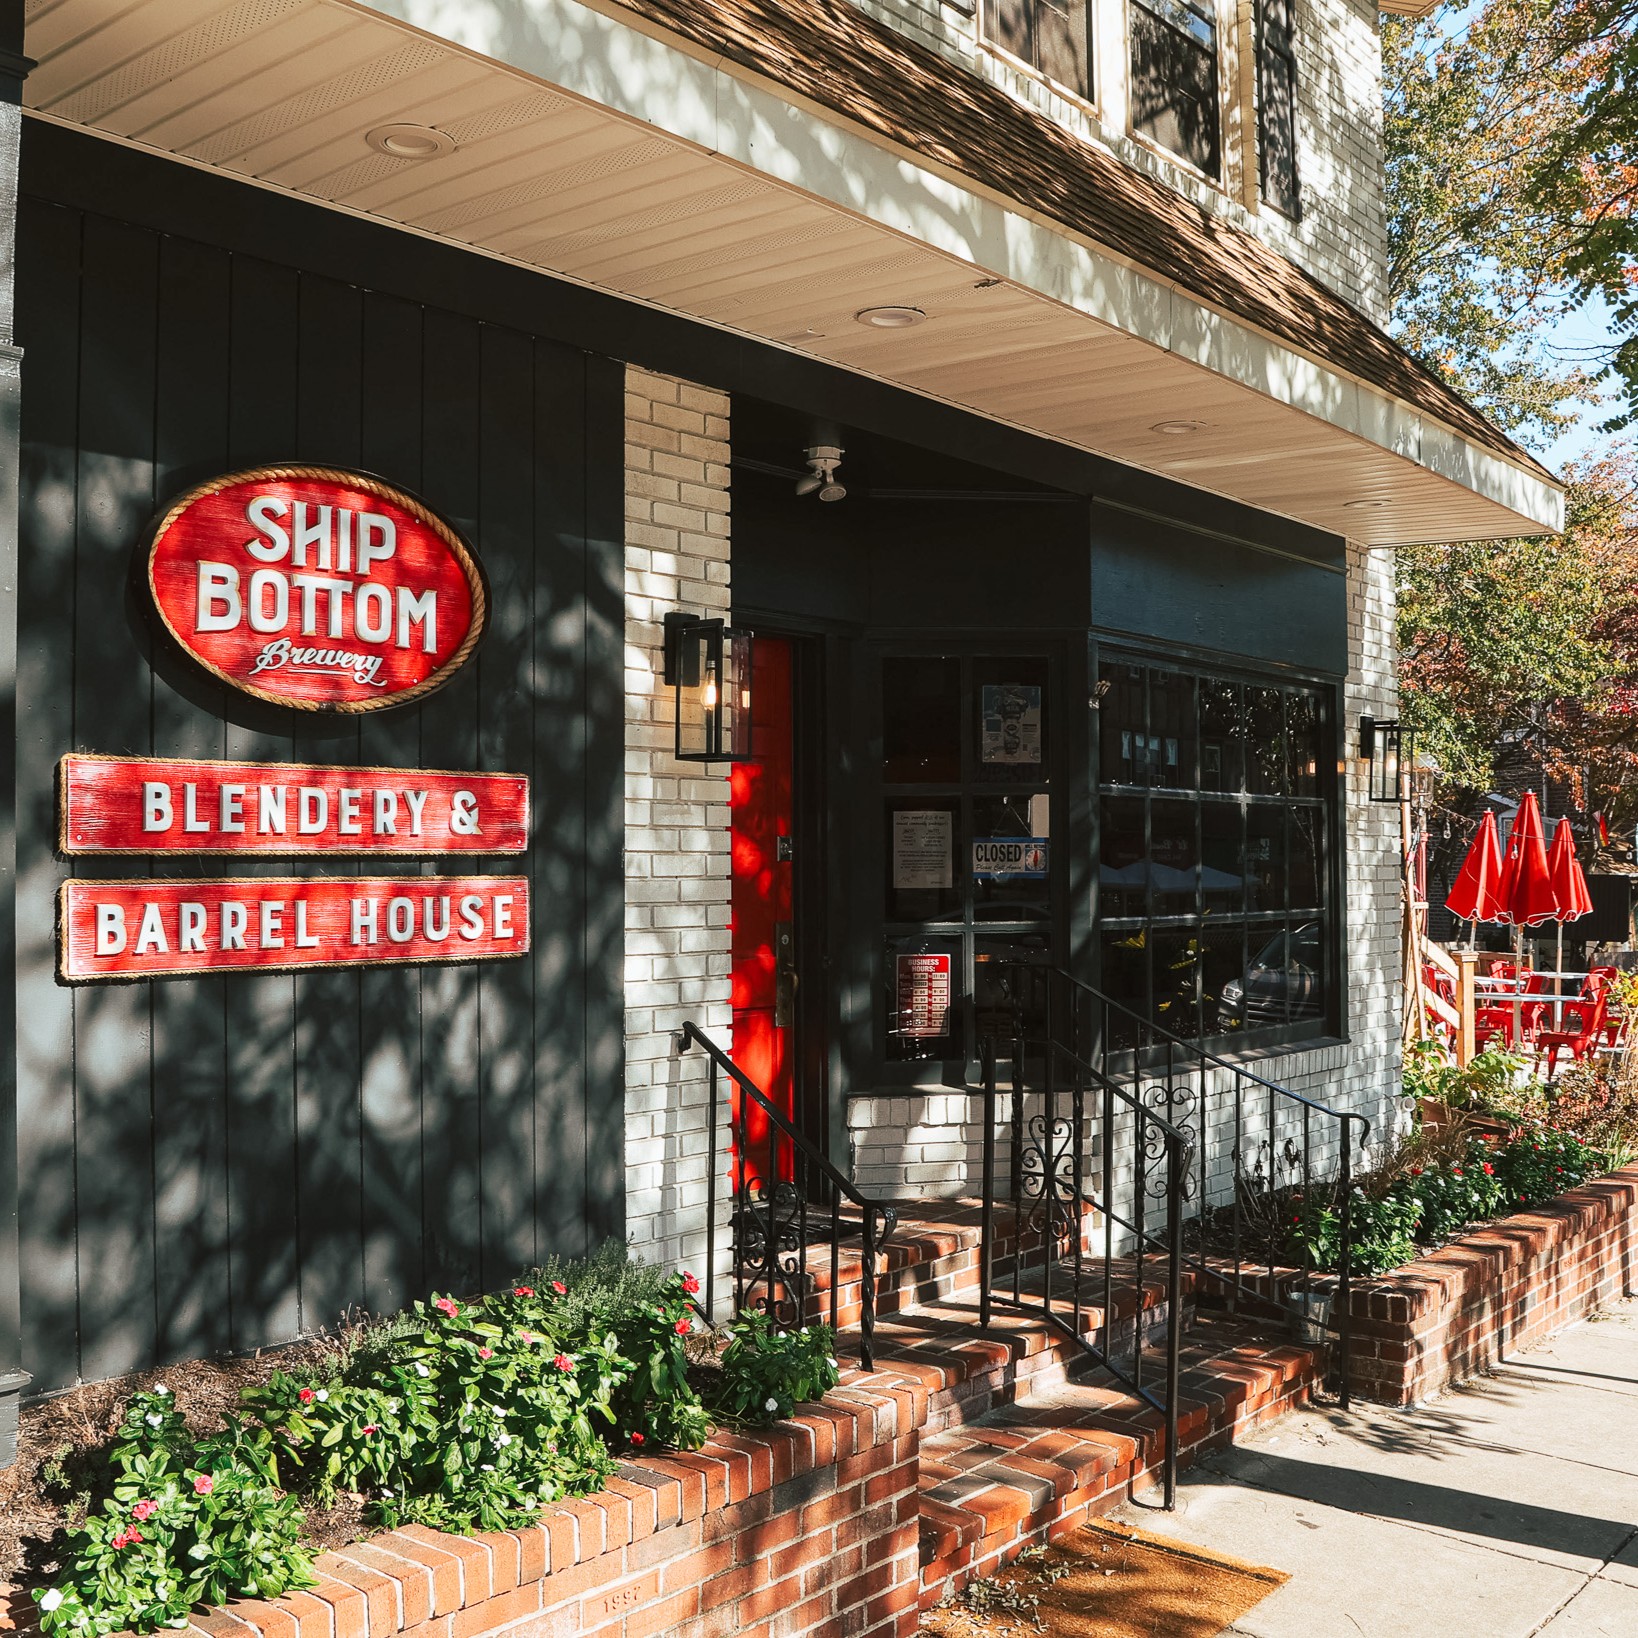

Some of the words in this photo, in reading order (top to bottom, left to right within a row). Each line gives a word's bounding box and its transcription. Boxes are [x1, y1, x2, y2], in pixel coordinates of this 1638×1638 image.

[245, 495, 397, 575] SHIP
[195, 560, 437, 654] BOTTOM
[249, 637, 387, 686] Brewery
[142, 782, 428, 835] BLENDERY
[450, 790, 483, 835] &
[976, 844, 1022, 862] CLOSED
[95, 899, 320, 956] BARREL
[350, 895, 515, 945] HOUSE
[603, 1586, 641, 1613] 1997
